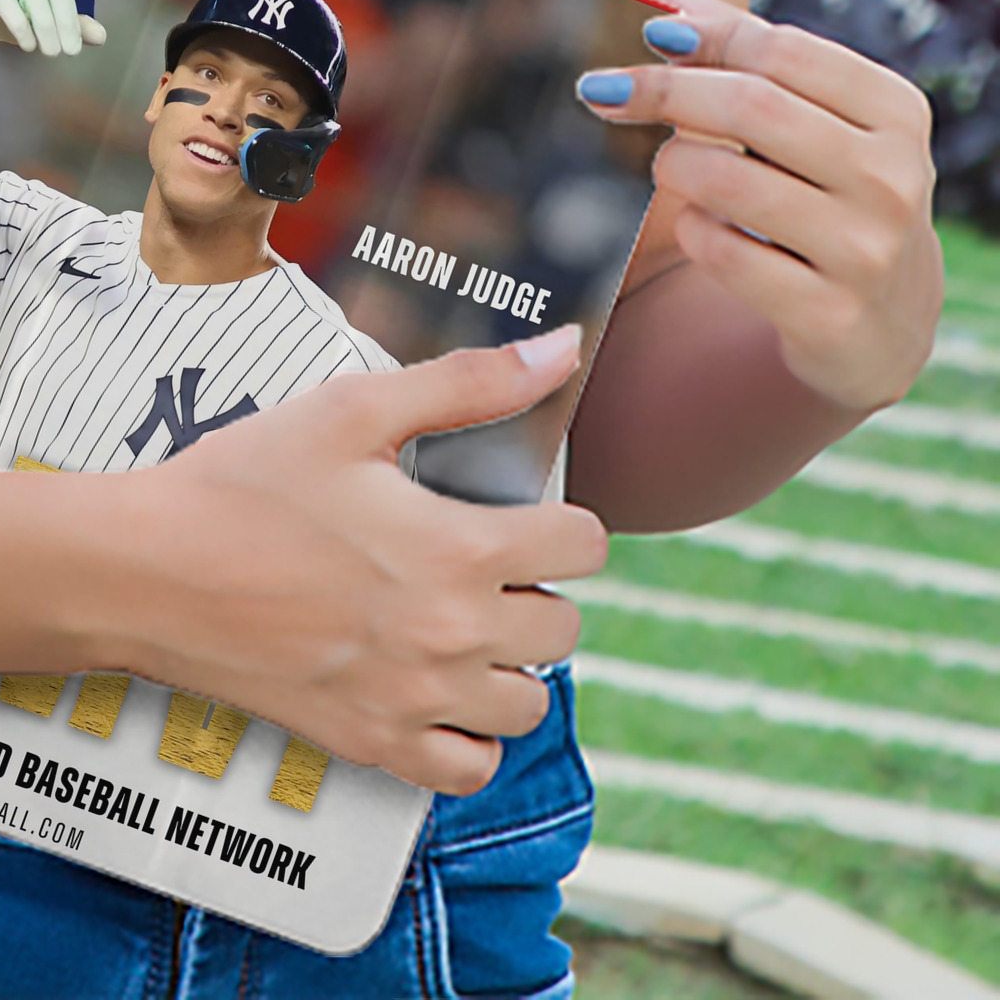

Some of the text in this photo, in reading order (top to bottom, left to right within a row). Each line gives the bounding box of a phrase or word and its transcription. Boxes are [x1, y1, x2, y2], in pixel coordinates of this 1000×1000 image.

[351, 224, 552, 325] AARON JUDGE
[14, 751, 160, 835] BASEBALL
[164, 806, 317, 891] NETWORK
